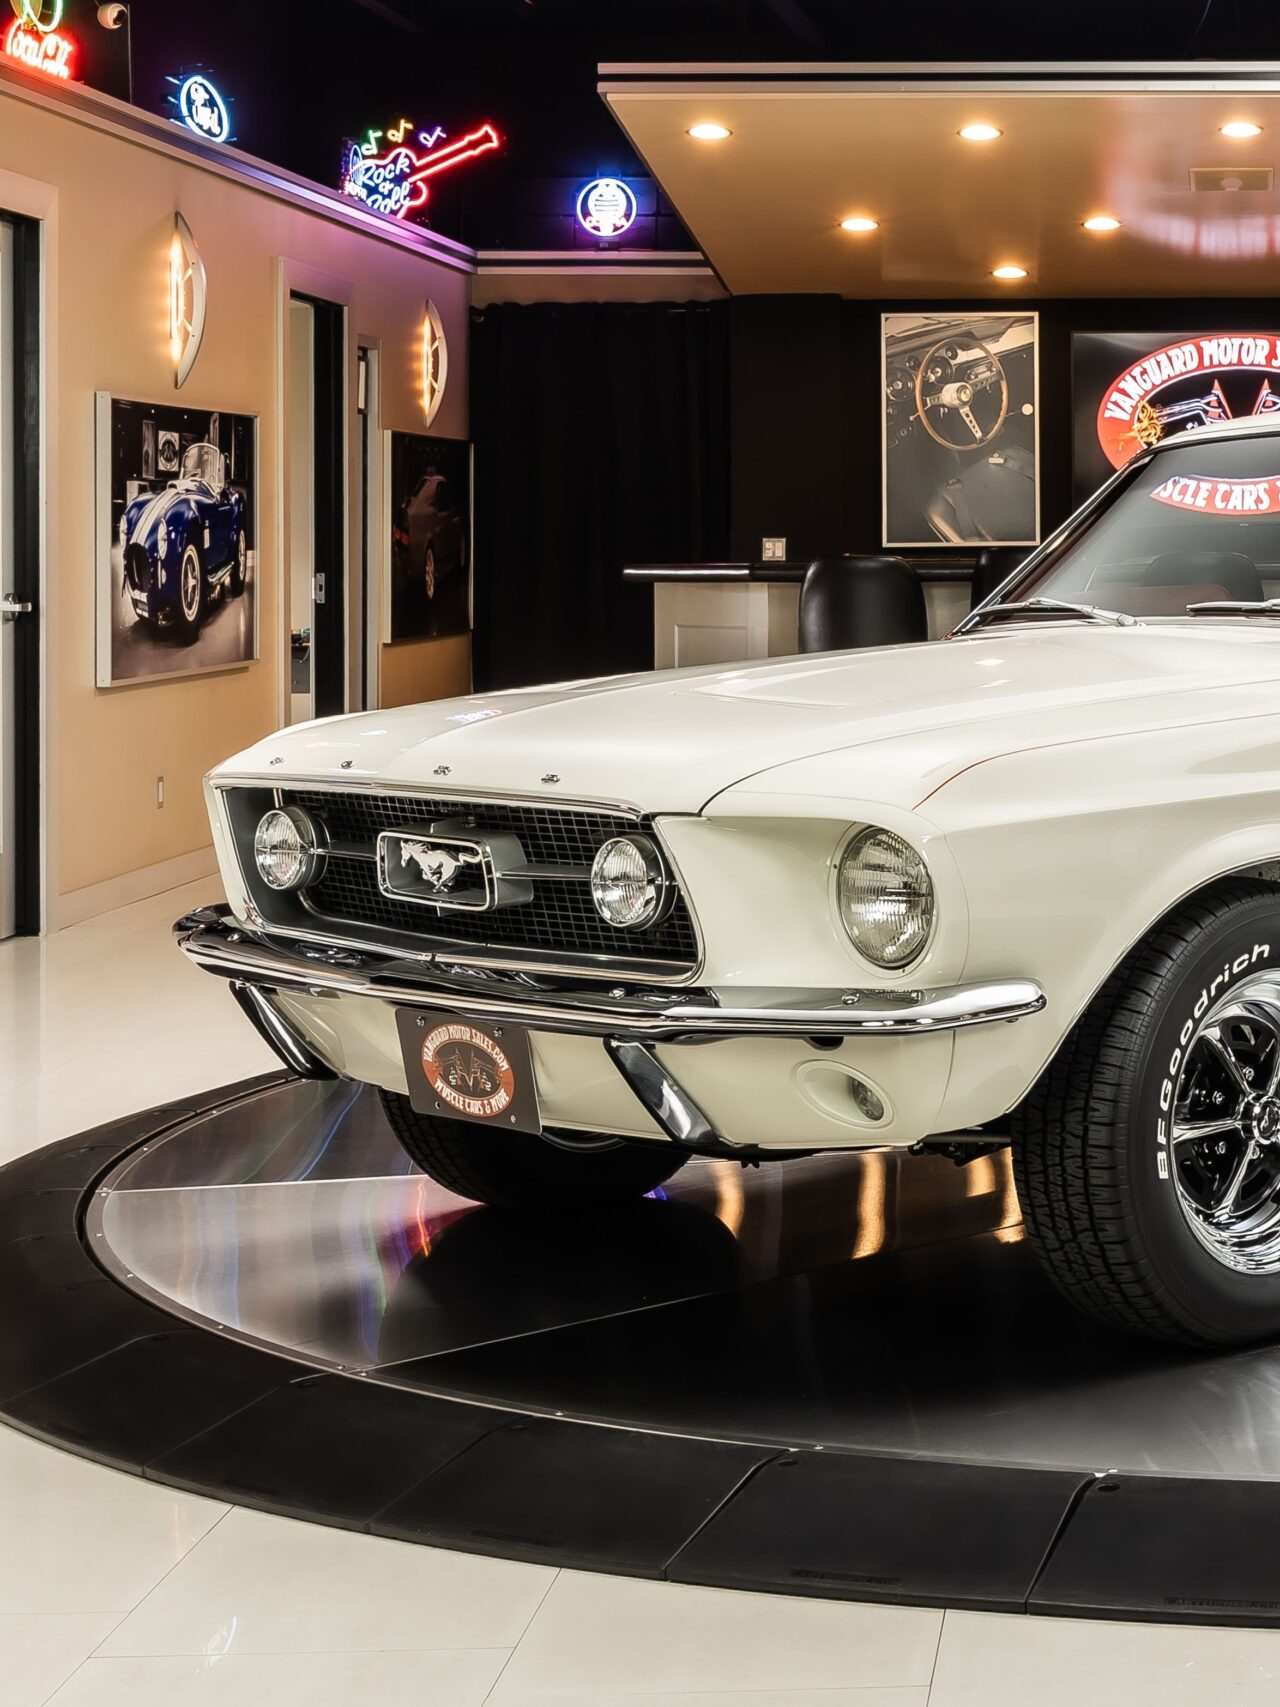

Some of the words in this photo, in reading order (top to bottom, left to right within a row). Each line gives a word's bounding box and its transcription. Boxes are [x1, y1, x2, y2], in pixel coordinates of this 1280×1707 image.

[360, 152, 411, 187] Rock
[1103, 343, 1199, 421] VANGUARD
[1200, 337, 1270, 367] MOTOR
[1214, 483, 1270, 511] CARS
[423, 1027, 450, 1062] VANGUARD
[448, 1025, 471, 1041] MOTOR
[471, 1029, 510, 1072] SALES.COM
[1157, 943, 1271, 1180] BFGoodrich
[434, 1079, 464, 1111] MUSCLE
[464, 1100, 484, 1115] CARS
[484, 1101, 492, 1114] &
[491, 1088, 510, 1112] MORE
